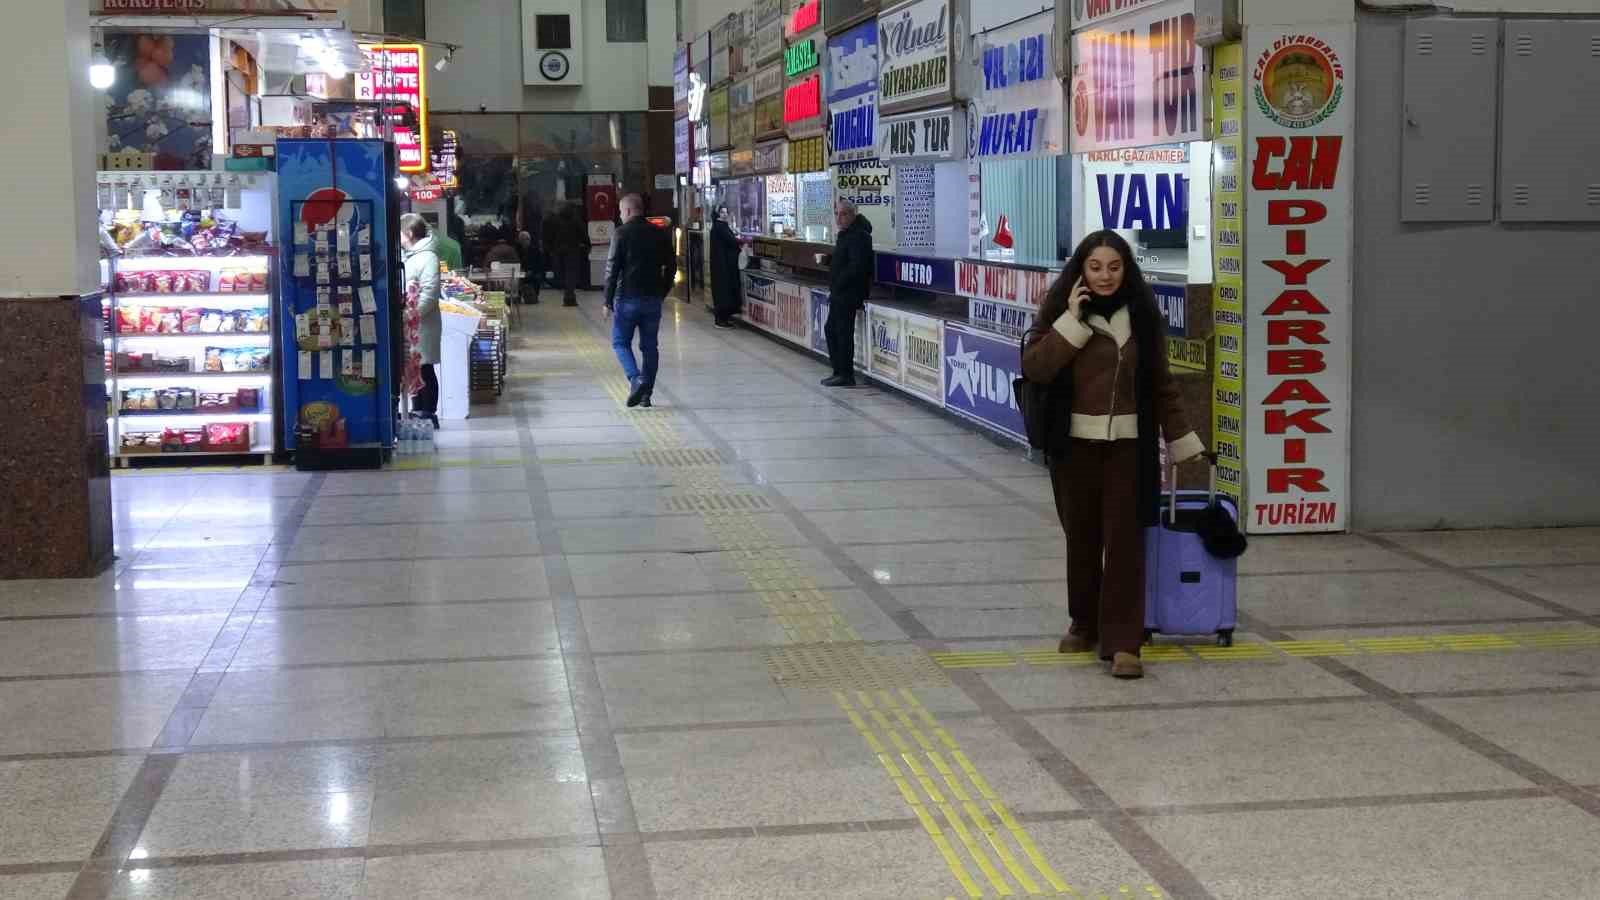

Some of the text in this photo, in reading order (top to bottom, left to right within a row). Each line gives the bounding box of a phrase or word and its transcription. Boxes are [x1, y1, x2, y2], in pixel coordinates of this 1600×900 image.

[883, 55, 947, 97] DİYARBAKIR
[1149, 12, 1197, 136] TUR
[923, 116, 950, 153] TUR
[978, 108, 1038, 157] MURAT
[838, 174, 889, 188] TOKAT
[1252, 135, 1343, 190] CAN
[1096, 173, 1184, 230] VAN
[901, 262, 932, 285] METRO
[1000, 305, 1026, 329] MURAT
[1254, 497, 1337, 526] TURİZM
